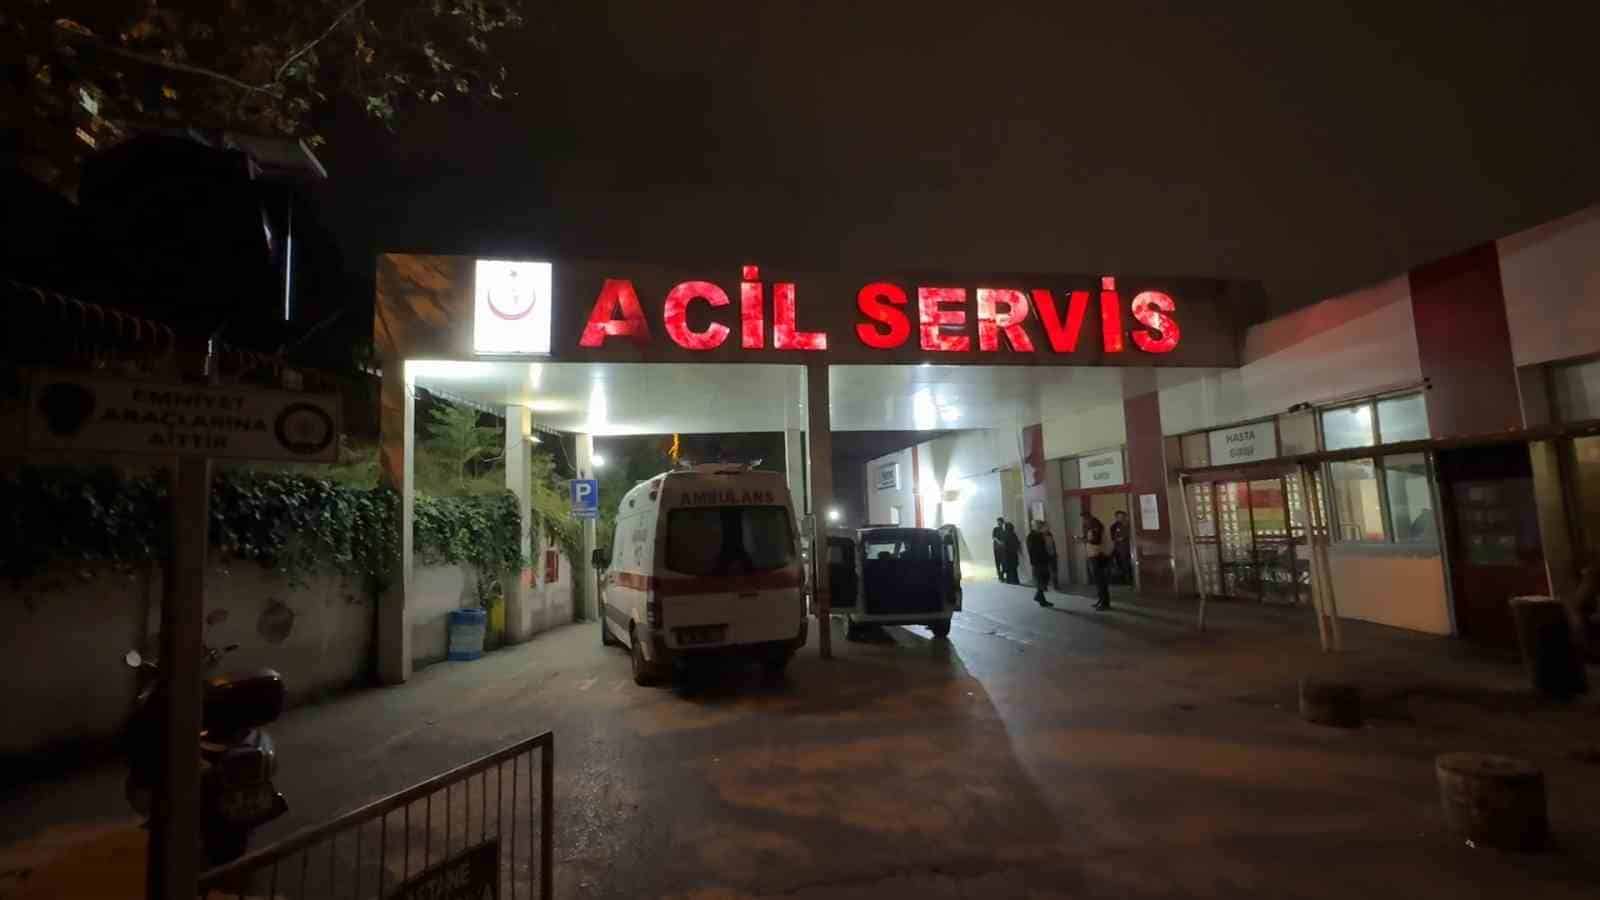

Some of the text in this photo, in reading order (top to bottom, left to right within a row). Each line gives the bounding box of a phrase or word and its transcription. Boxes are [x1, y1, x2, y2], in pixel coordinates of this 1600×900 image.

[579, 265, 1182, 353] ACİL SERVİS
[576, 483, 591, 502] P
[680, 488, 775, 505] AMBULANS
